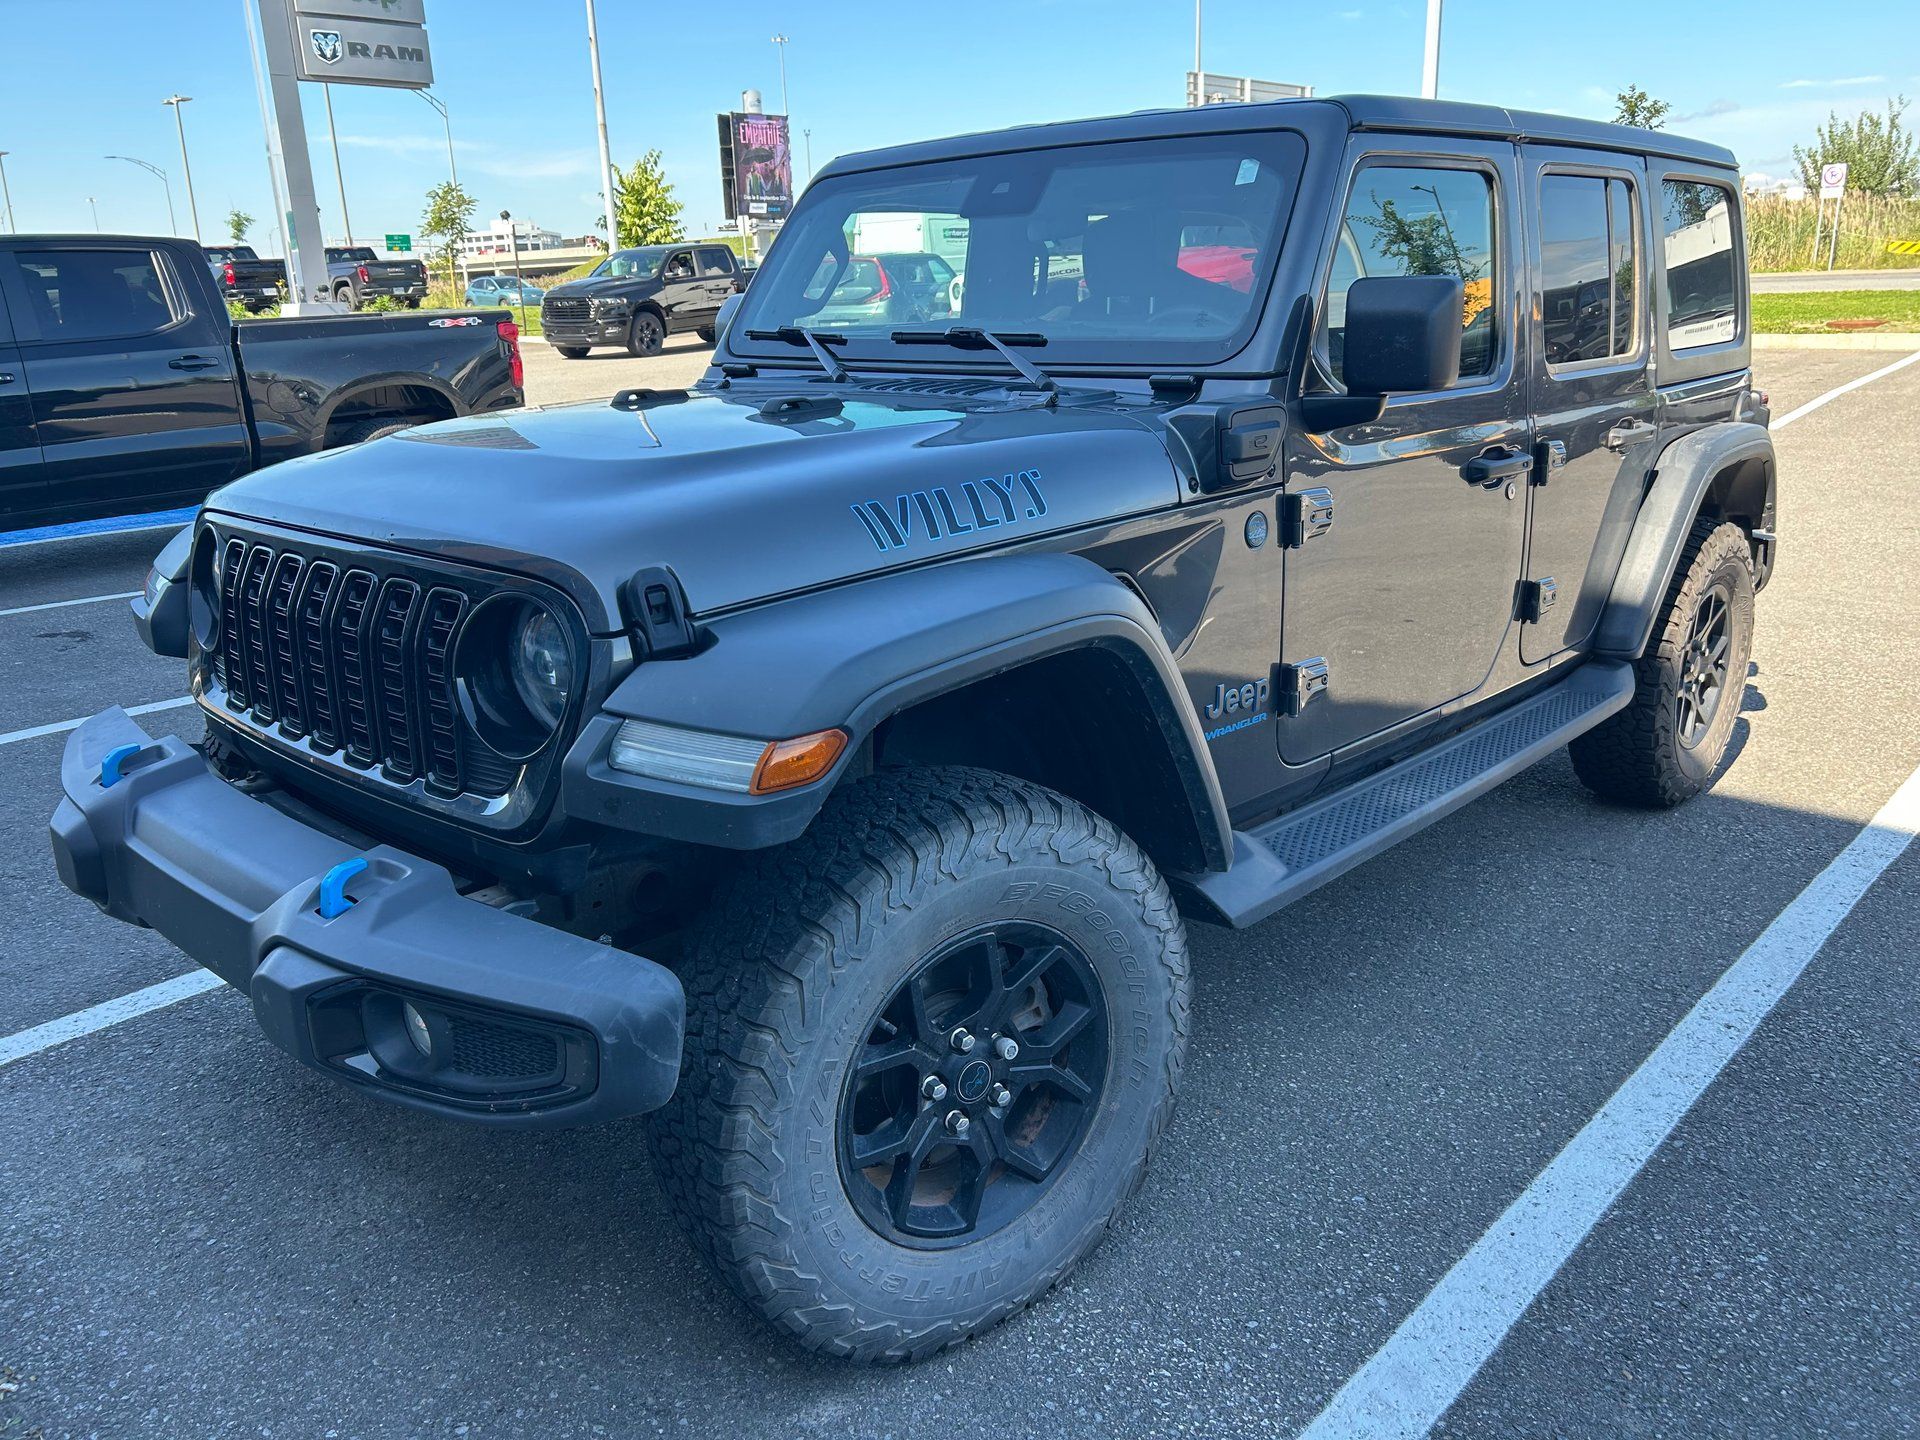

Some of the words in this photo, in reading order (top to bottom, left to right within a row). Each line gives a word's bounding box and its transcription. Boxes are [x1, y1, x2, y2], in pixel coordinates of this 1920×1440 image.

[347, 42, 424, 62] RAM
[740, 123, 783, 145] EMPATHIE
[1049, 268, 1080, 277] BICON
[850, 469, 1048, 551] WILLYS
[1204, 678, 1270, 720] Jeep
[1205, 712, 1268, 741] WRANGLER
